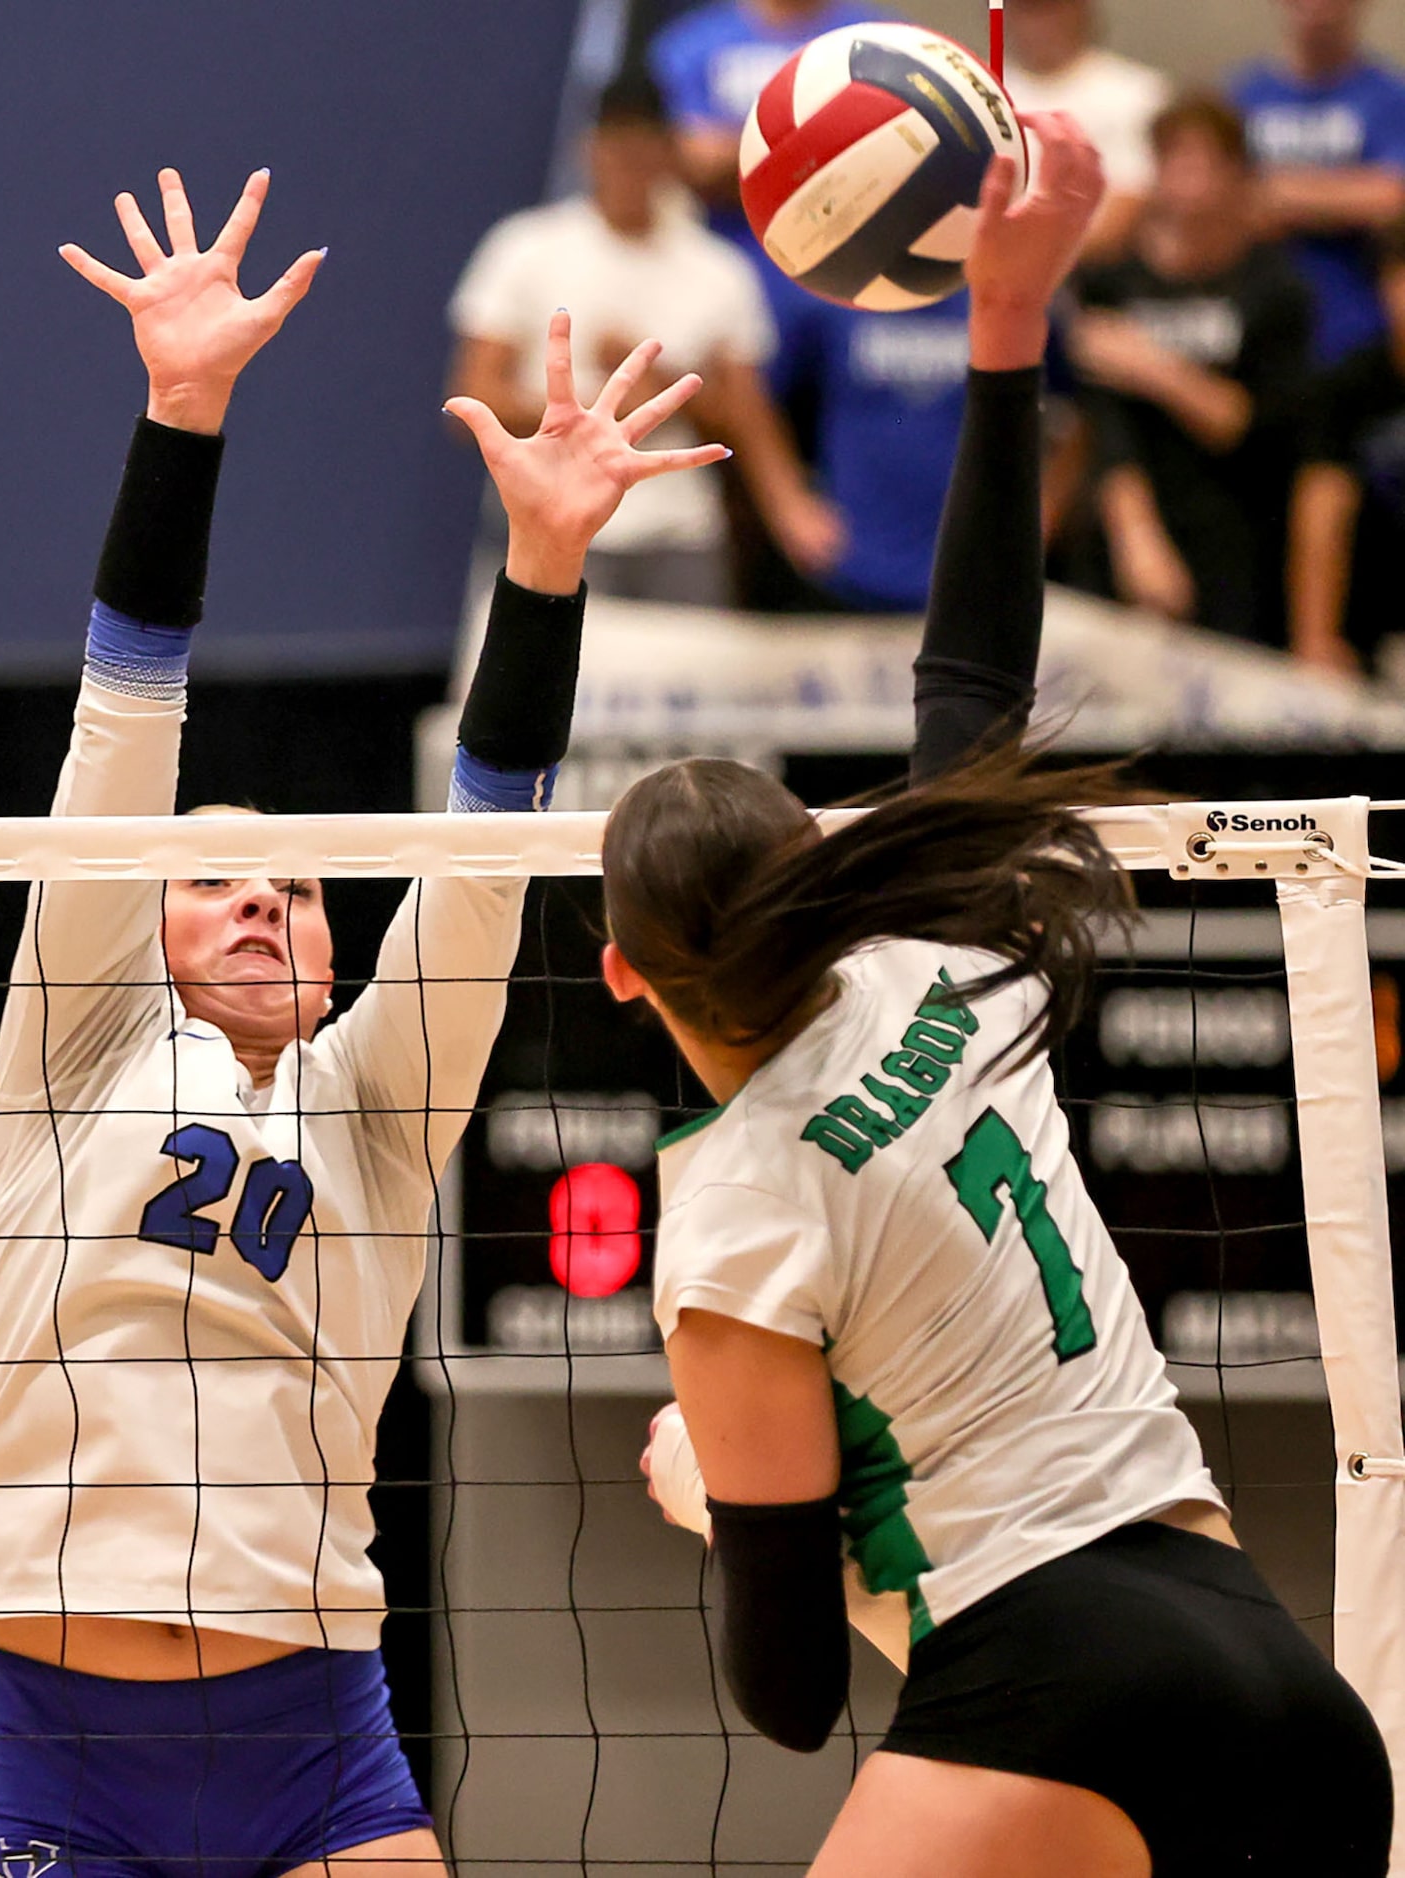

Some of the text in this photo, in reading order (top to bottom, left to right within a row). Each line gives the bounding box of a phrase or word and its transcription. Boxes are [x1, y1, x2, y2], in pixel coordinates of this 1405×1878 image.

[1231, 814, 1316, 832] Senoh
[137, 1122, 314, 1283] 20
[942, 1104, 1098, 1366] 7
